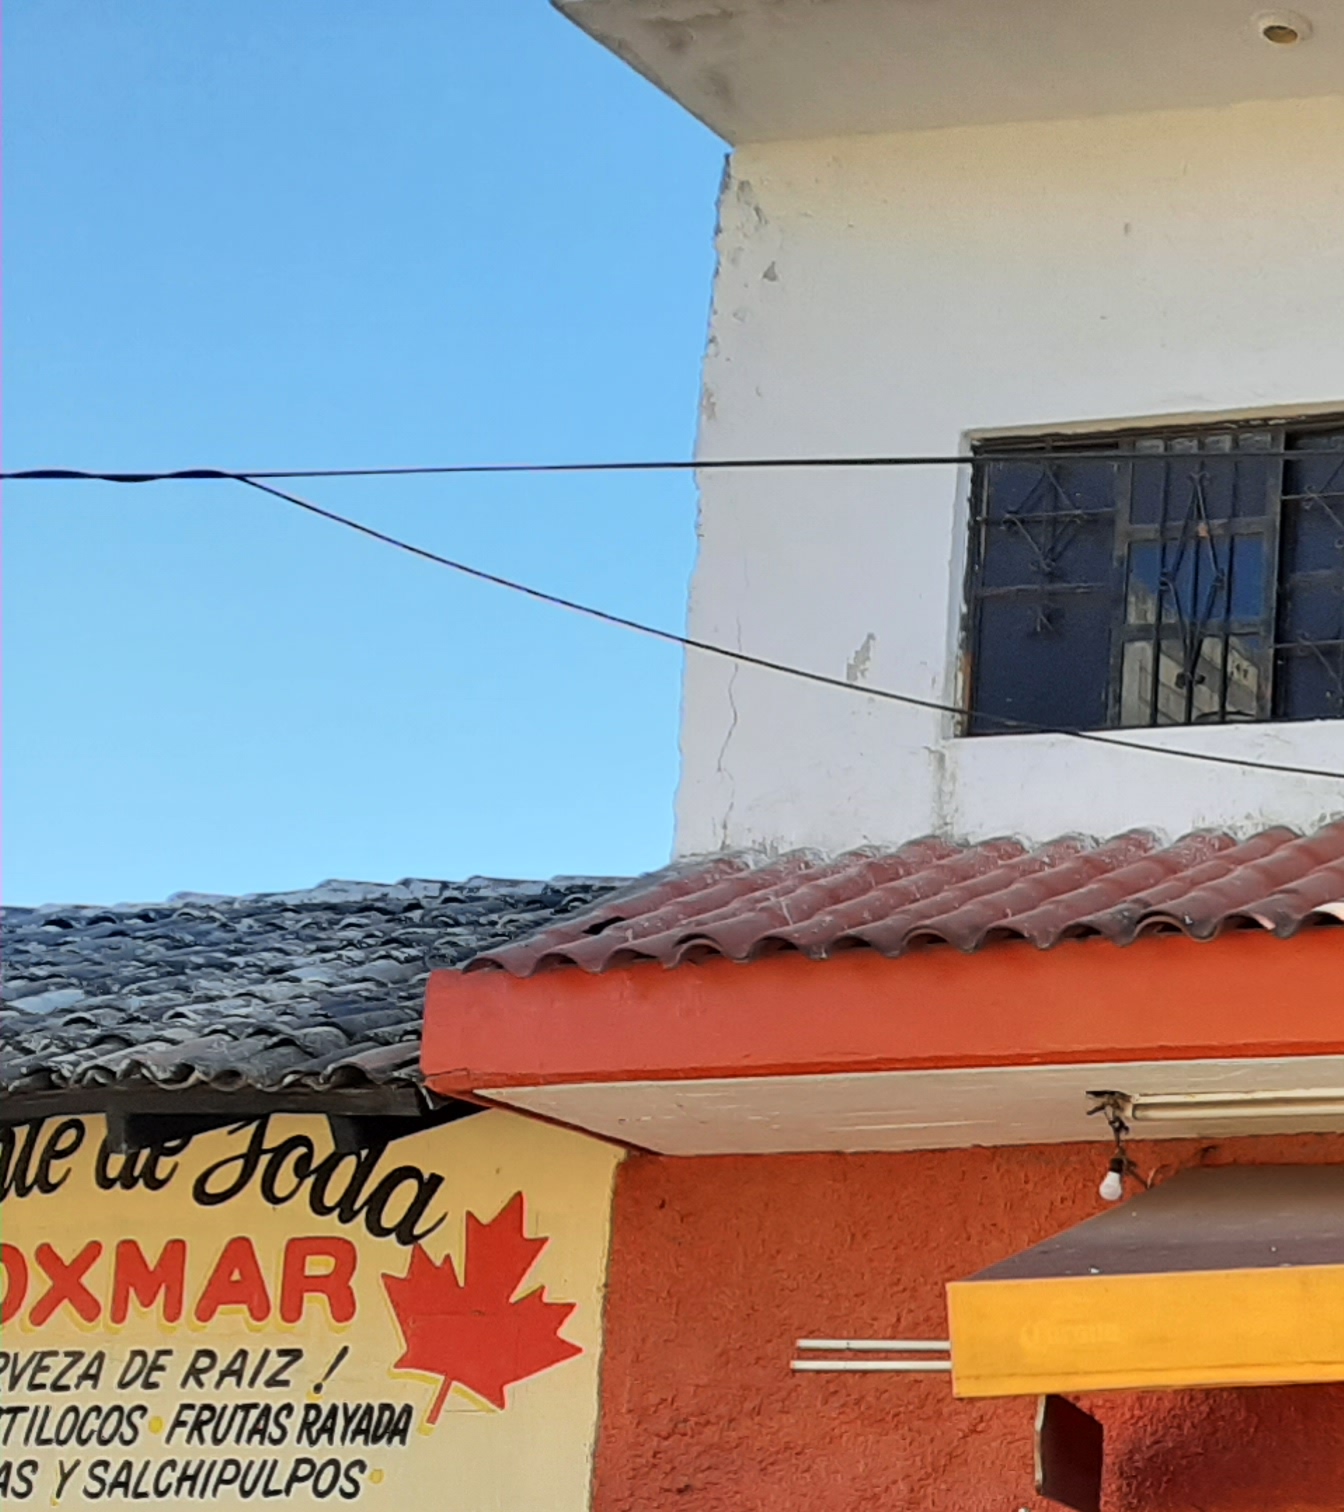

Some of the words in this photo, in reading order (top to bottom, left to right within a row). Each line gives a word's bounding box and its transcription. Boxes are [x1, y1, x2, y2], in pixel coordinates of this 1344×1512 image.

[193, 1117, 449, 1247] Soda
[116, 1348, 174, 1391] DE
[180, 1348, 304, 1391] RAIZ
[0, 1403, 148, 1447] TILOCOS
[165, 1402, 294, 1447] FRUTAS
[296, 1402, 414, 1448] RAYADA
[55, 1458, 82, 1499] Y
[82, 1457, 368, 1500] SALCHIPULPOS
